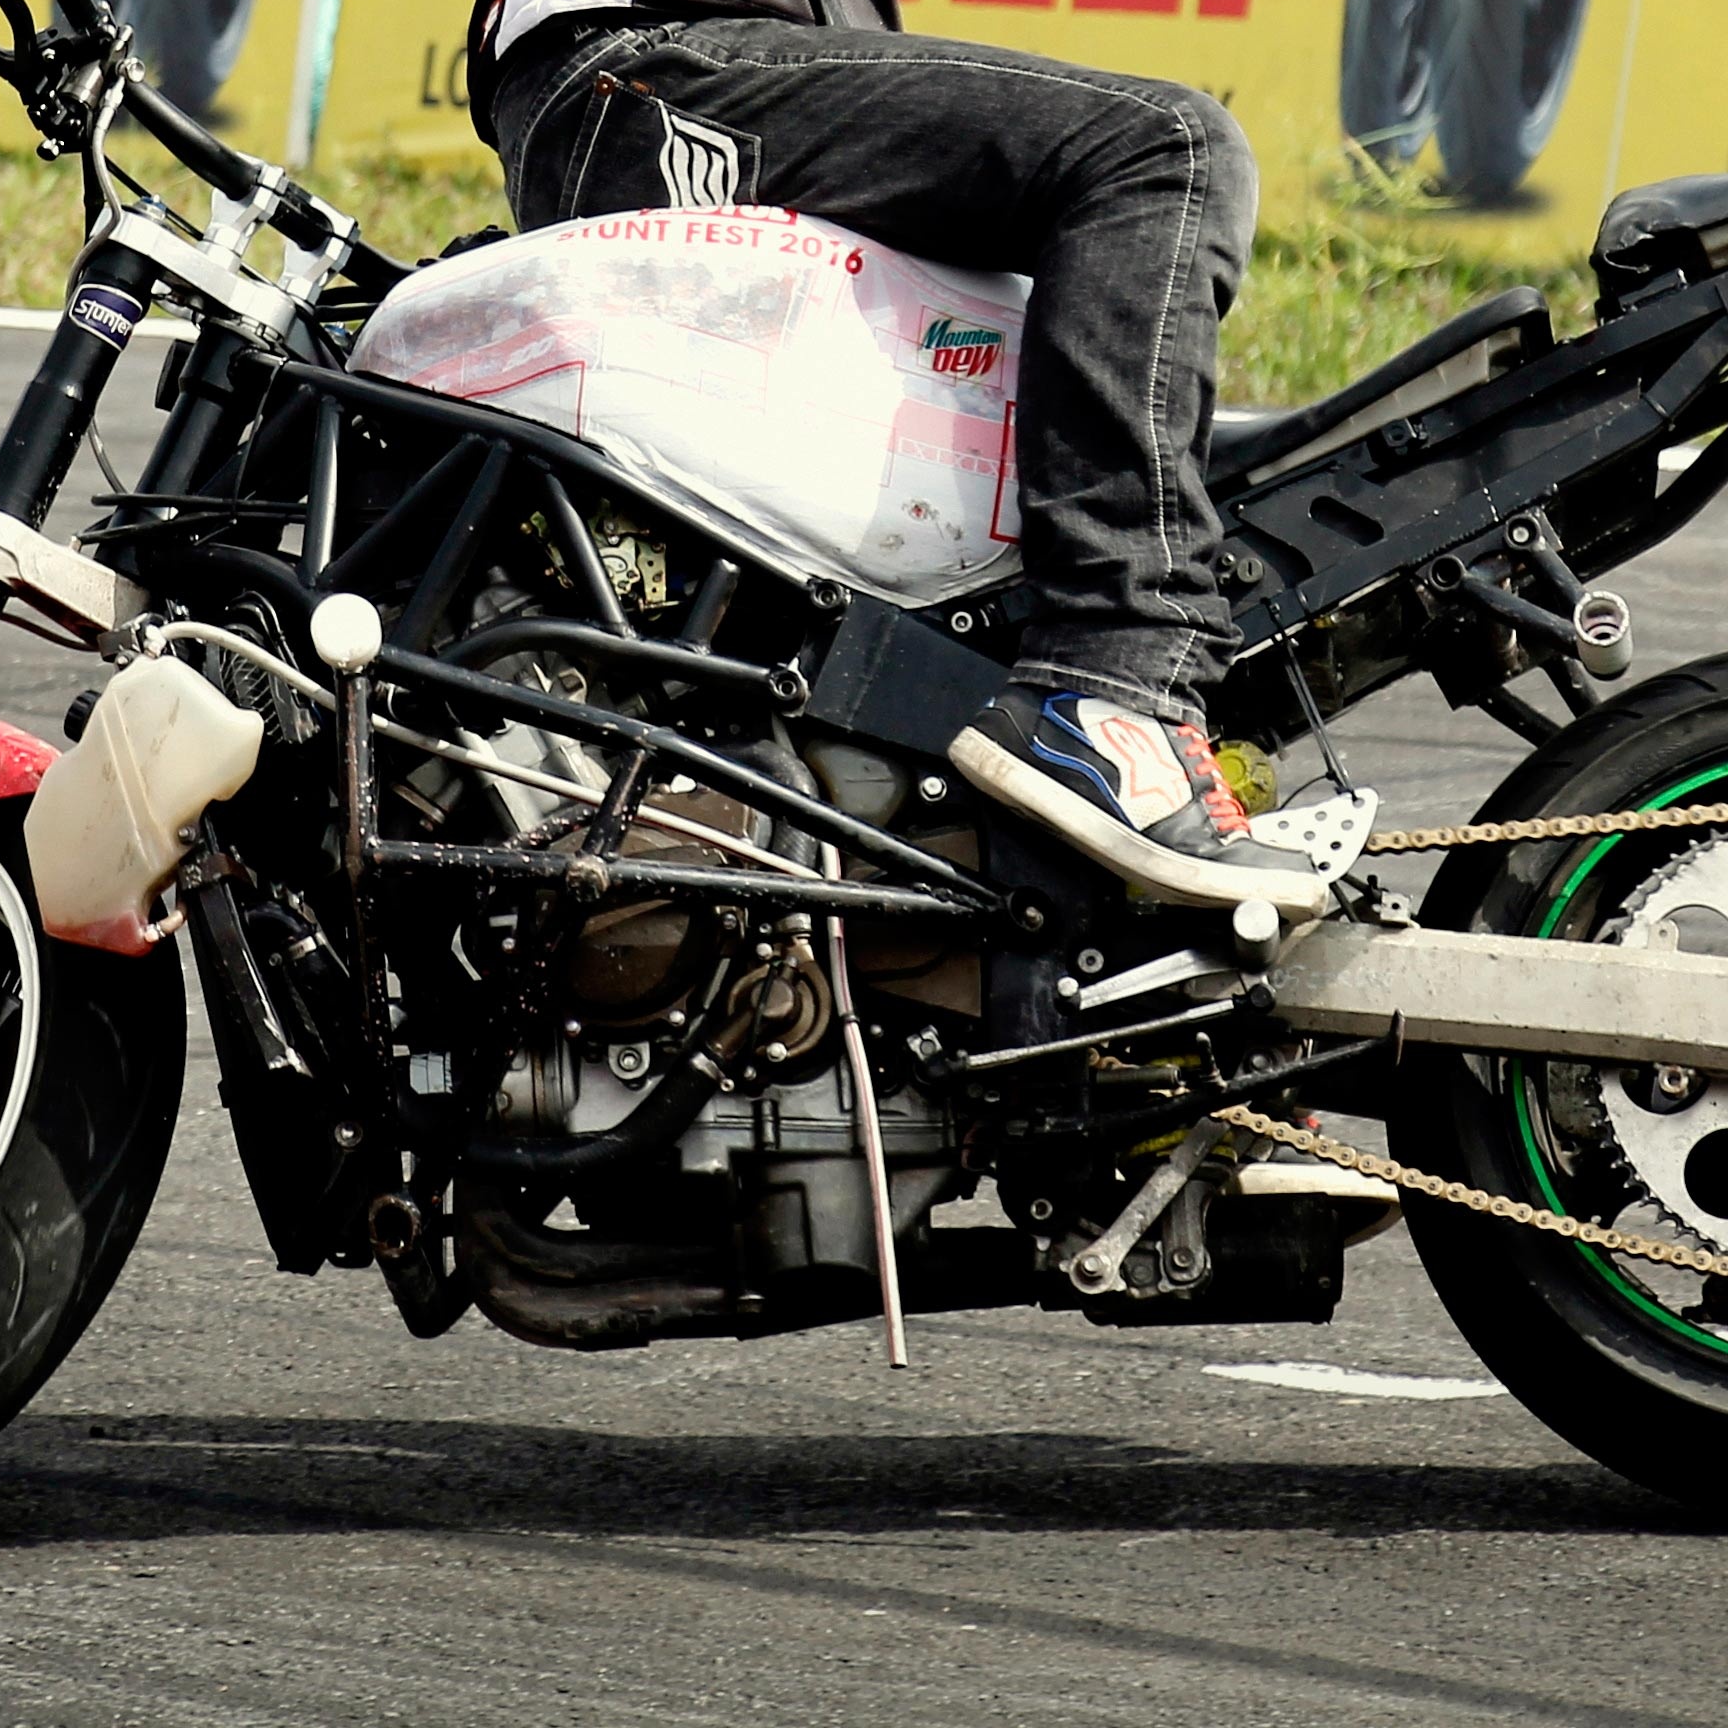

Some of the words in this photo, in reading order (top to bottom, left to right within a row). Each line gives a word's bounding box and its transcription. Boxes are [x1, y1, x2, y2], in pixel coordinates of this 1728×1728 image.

[556, 218, 672, 243] STUNT
[684, 222, 764, 248] FEST
[778, 231, 864, 276] 2016
[921, 318, 1002, 351] Mountain
